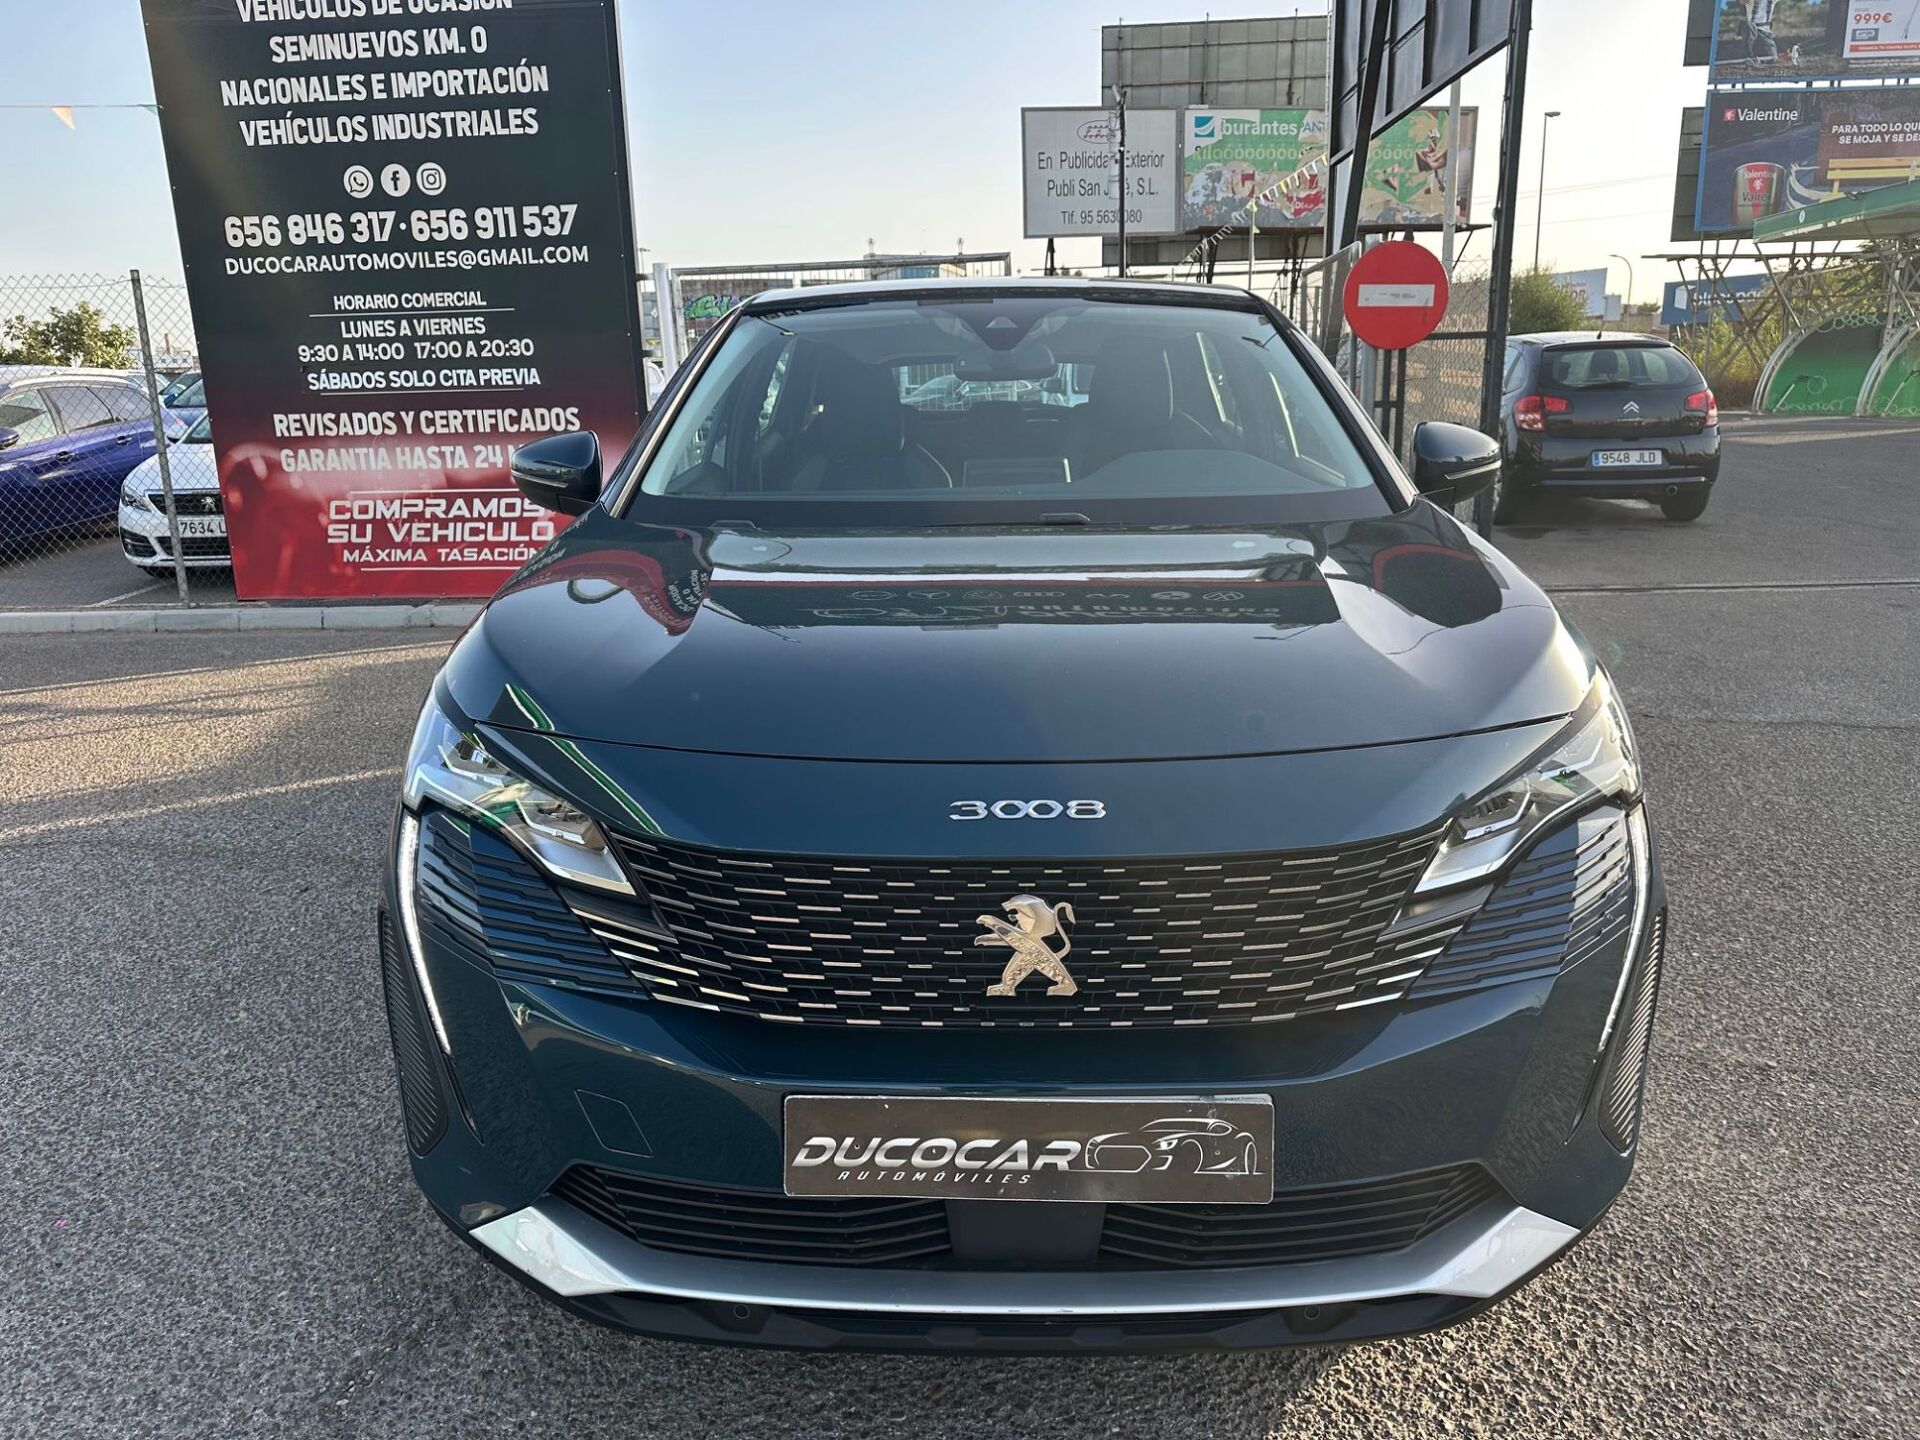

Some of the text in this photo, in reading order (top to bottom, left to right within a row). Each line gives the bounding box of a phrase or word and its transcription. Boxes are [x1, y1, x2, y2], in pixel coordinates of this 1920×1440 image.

[1854, 12, 1892, 24] 999€
[269, 25, 488, 63] SEMINUEVOS KM. 0
[220, 58, 549, 106] NACIONALES E IMPORTACIÓN
[1737, 107, 1798, 121] Valentine
[239, 107, 539, 147] VEHÍCULOS INDUSTRIALES
[1832, 124, 1858, 134] PARA
[1860, 123, 1888, 133] TODO
[1889, 122, 1902, 132] LO
[1839, 135, 1852, 145] SE
[1853, 134, 1881, 144] MOJA
[1884, 134, 1891, 143] Y
[1891, 133, 1904, 142] SE
[1038, 151, 1053, 170] En
[1047, 178, 1075, 197] Publi
[1078, 178, 1100, 197] San
[1136, 177, 1159, 195] S.L.
[224, 214, 282, 248] 656
[287, 212, 345, 246] 846
[474, 206, 518, 239] 911
[522, 204, 578, 238] 537
[1080, 210, 1094, 224] 95
[225, 245, 590, 275] DUCOCARAUTOMOVILES@GMAIL.COM
[333, 291, 487, 311] HORARIO COMERCIAL
[340, 316, 486, 339] LUNES A VIERNES
[298, 338, 535, 362] 9:30 A 14:00 17:00 A 20:30
[307, 367, 541, 391] SÁBADOS SOLO CITA PREVIA
[273, 407, 581, 437] REVISADOS Y CERTIFICADOS
[280, 446, 393, 472] GARANTIA
[396, 445, 469, 470] HASTA
[473, 444, 503, 468] 24
[1602, 452, 1656, 463] 9548 JLD
[329, 497, 546, 520] COMPRAMOS
[180, 521, 215, 534] 7634
[327, 520, 554, 543] SU VEHICULO
[343, 545, 428, 562] MÁXIMA
[950, 800, 1106, 820] 3008
[792, 1136, 1083, 1171] DUCOCAR
[837, 1168, 1032, 1184] AUTOMÓVILES
